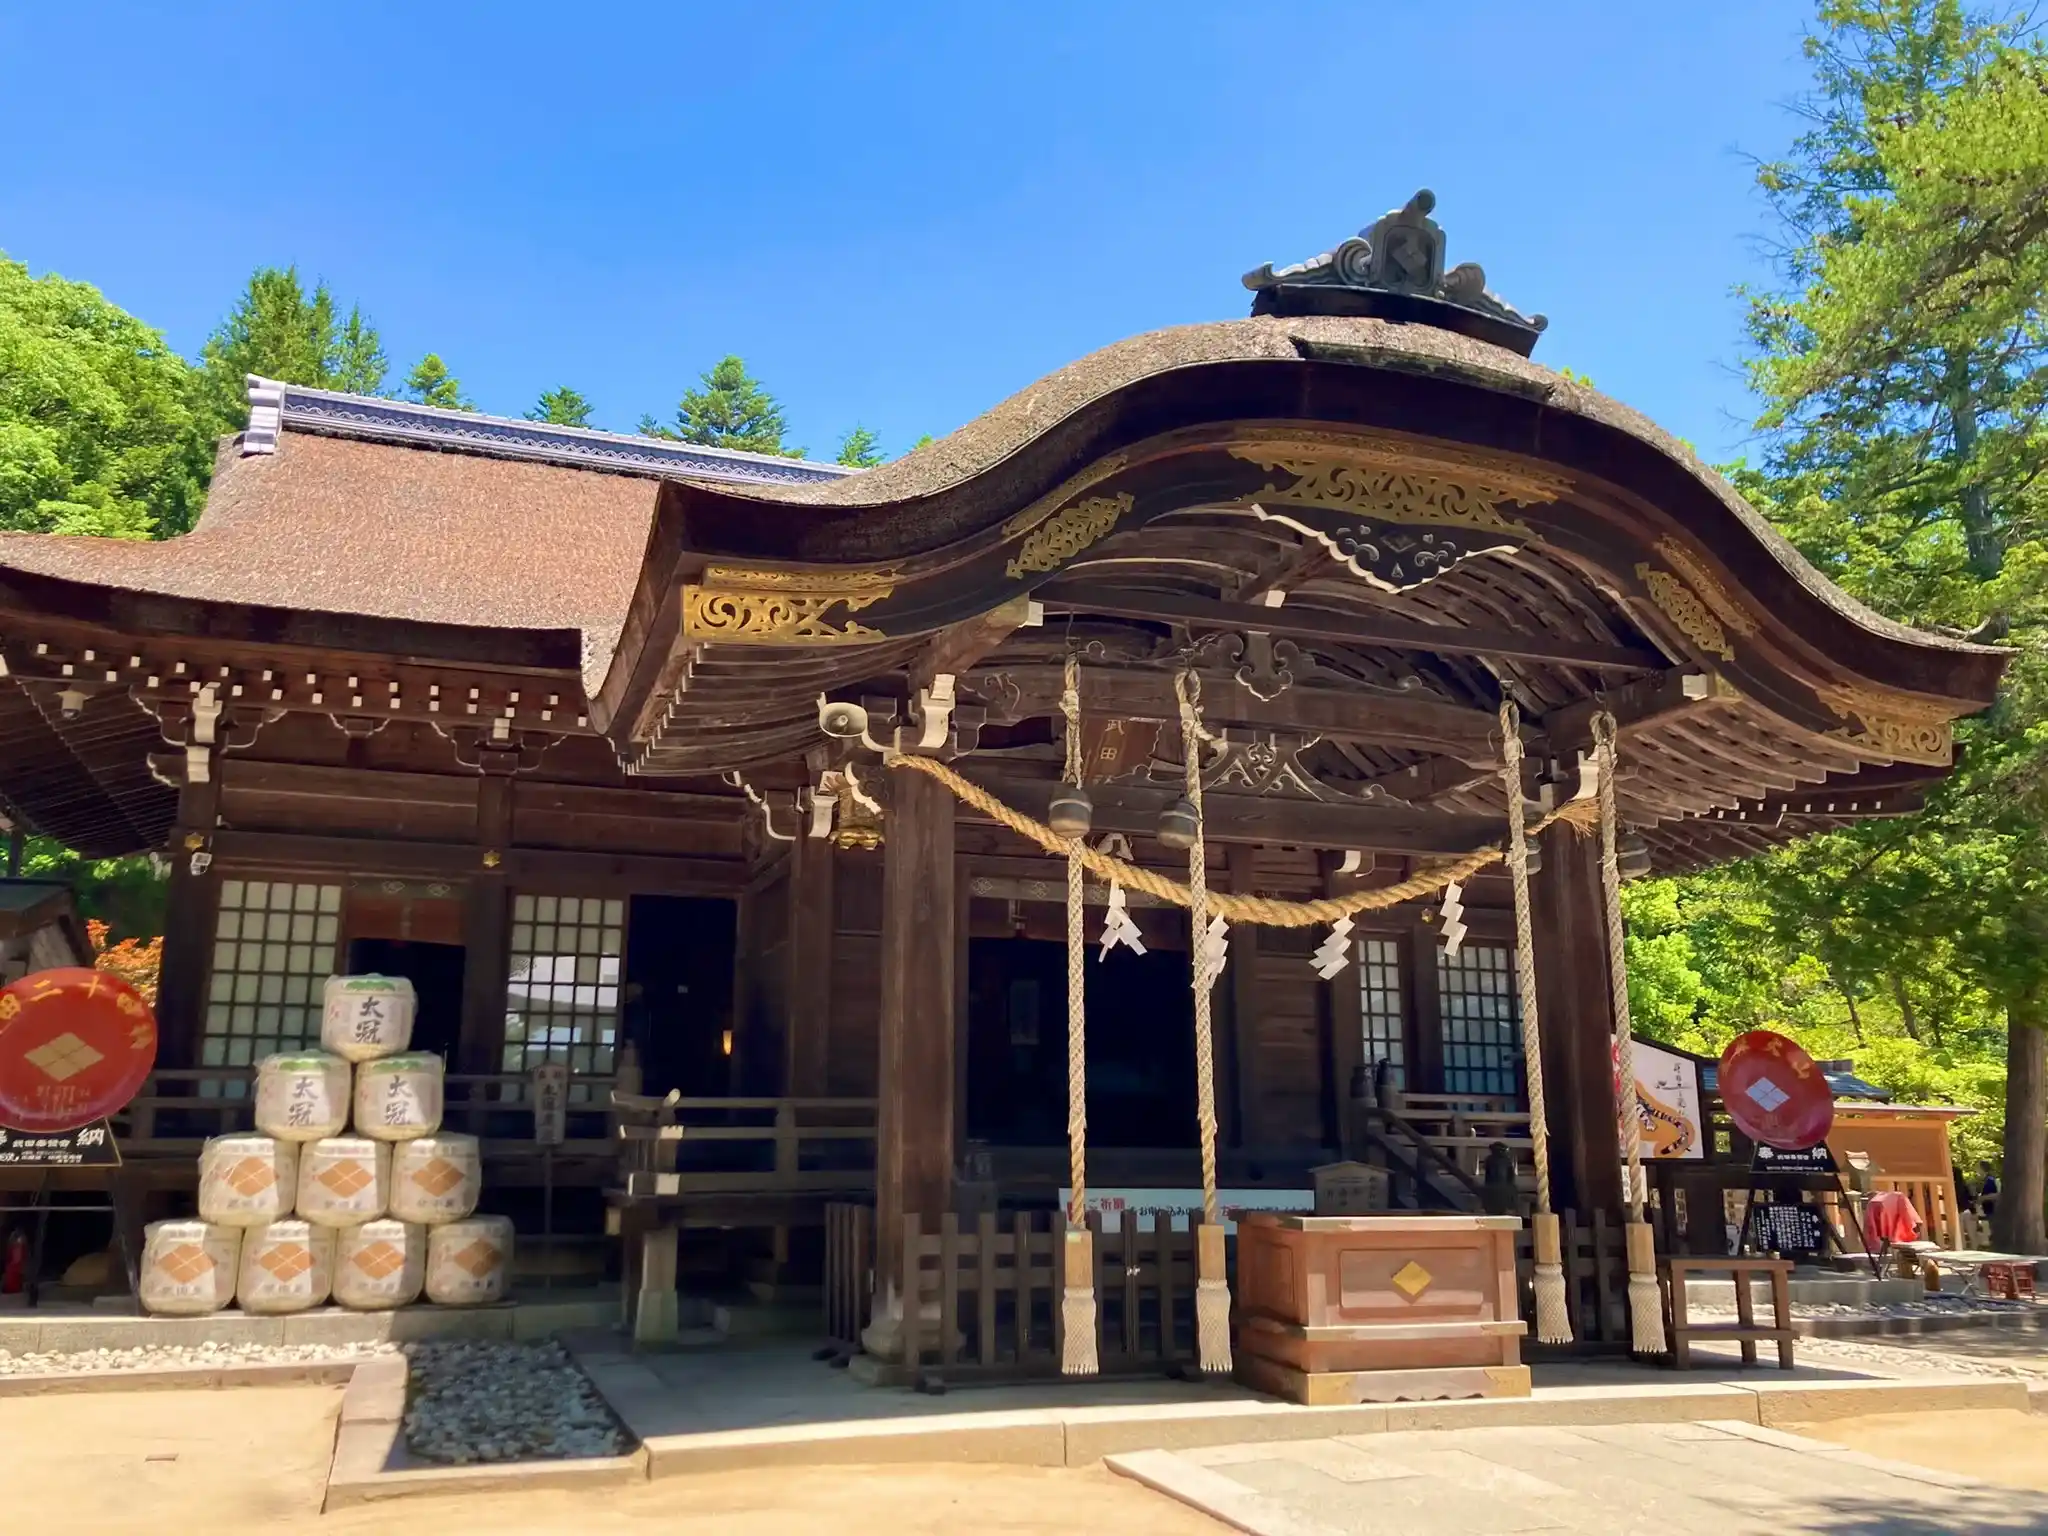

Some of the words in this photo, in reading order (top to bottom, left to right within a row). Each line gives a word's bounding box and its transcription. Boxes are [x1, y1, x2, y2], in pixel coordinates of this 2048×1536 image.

[76, 1128, 105, 1147] 納
[1758, 1147, 1774, 1159] 奉
[1812, 1147, 1828, 1159] 納
